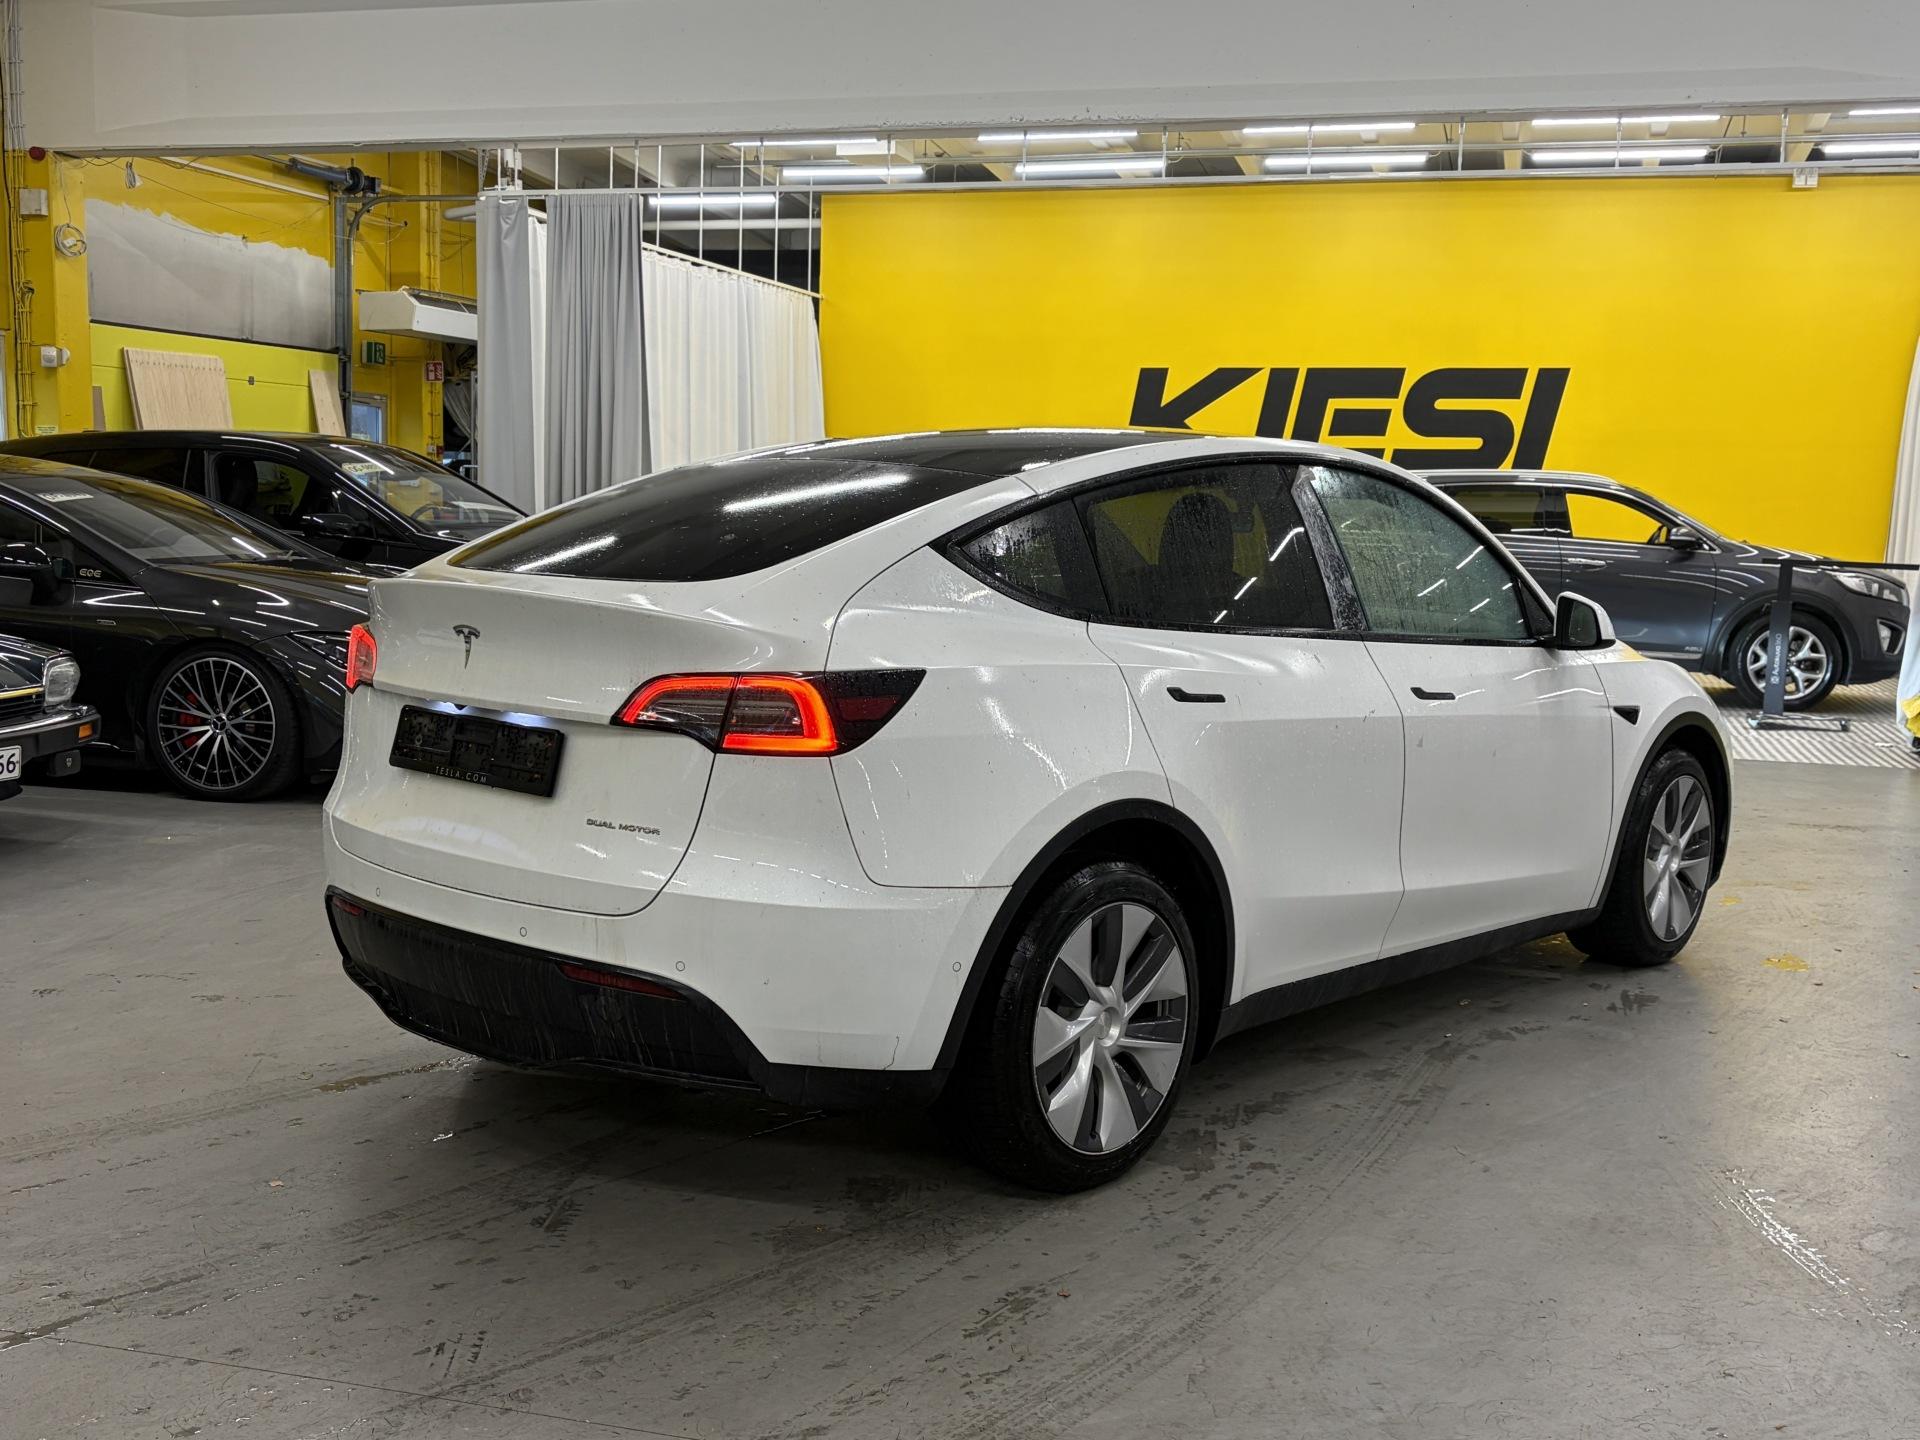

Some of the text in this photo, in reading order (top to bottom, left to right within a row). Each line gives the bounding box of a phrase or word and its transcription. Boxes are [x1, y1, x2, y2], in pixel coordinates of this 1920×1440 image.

[1129, 367, 1571, 470] KIESI
[80, 568, 102, 578] EQE
[435, 766, 487, 783] TESLA.COM
[586, 818, 661, 836] DUAL MOTOR
